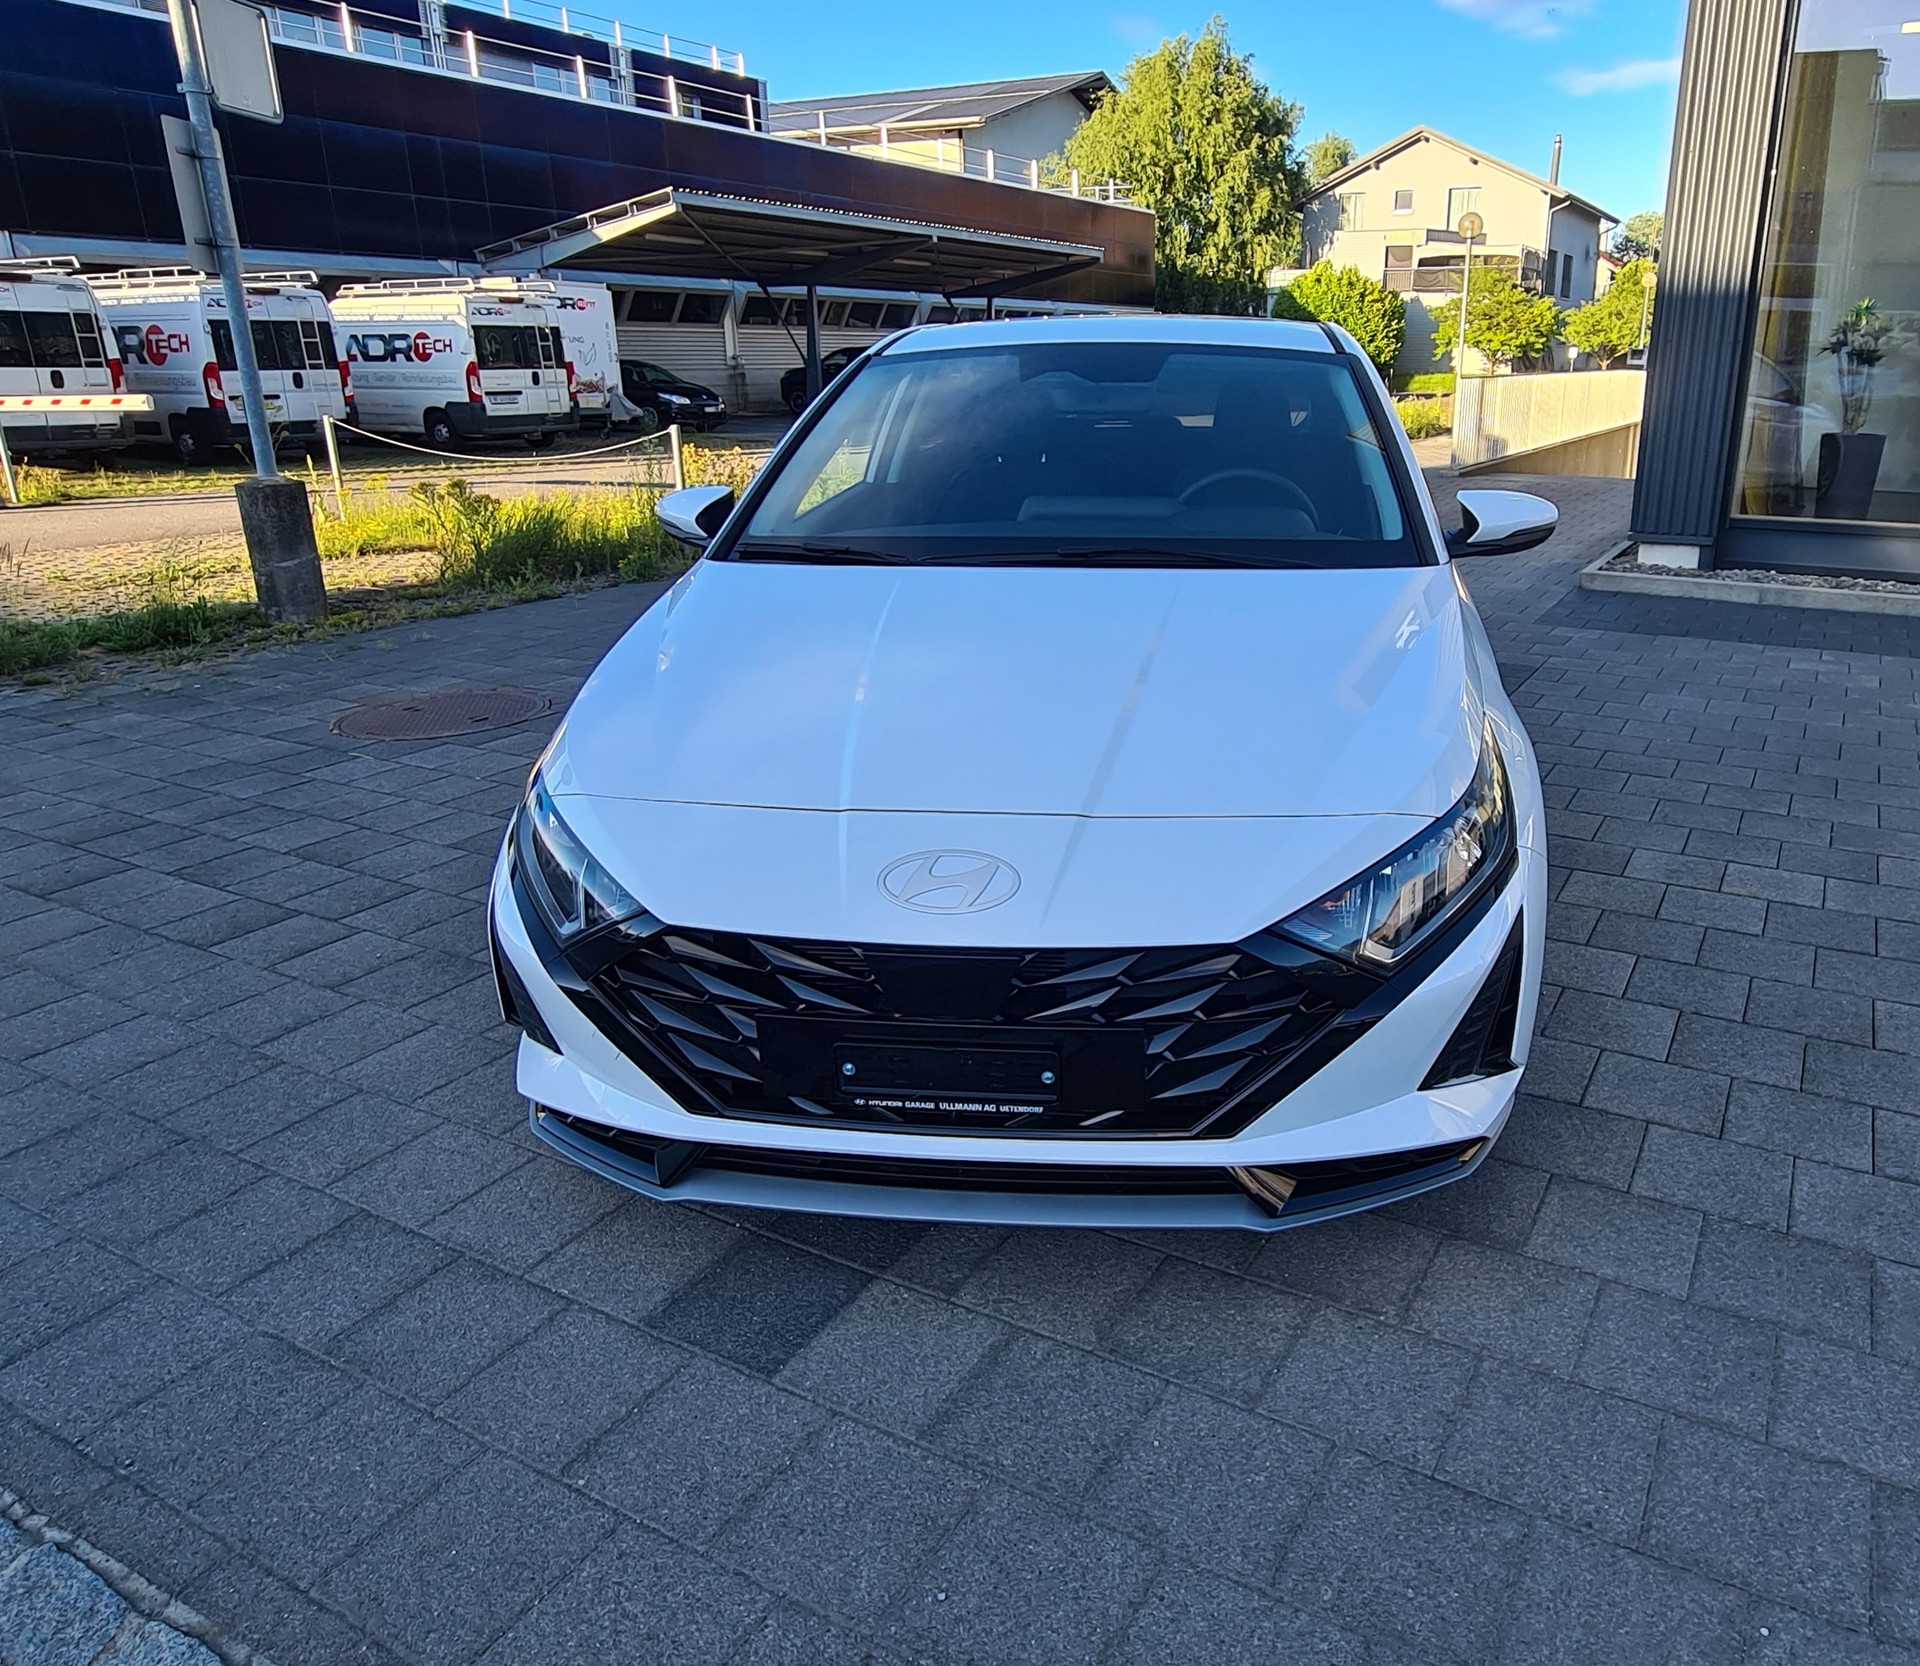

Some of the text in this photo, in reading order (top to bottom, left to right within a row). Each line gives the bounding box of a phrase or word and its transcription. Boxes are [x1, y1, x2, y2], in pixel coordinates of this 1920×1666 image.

[905, 1101, 936, 1109] GARAGE
[939, 1102, 982, 1111] ULLMANN
[983, 1104, 997, 1112] AG
[999, 1105, 1045, 1114] UETENDORF
